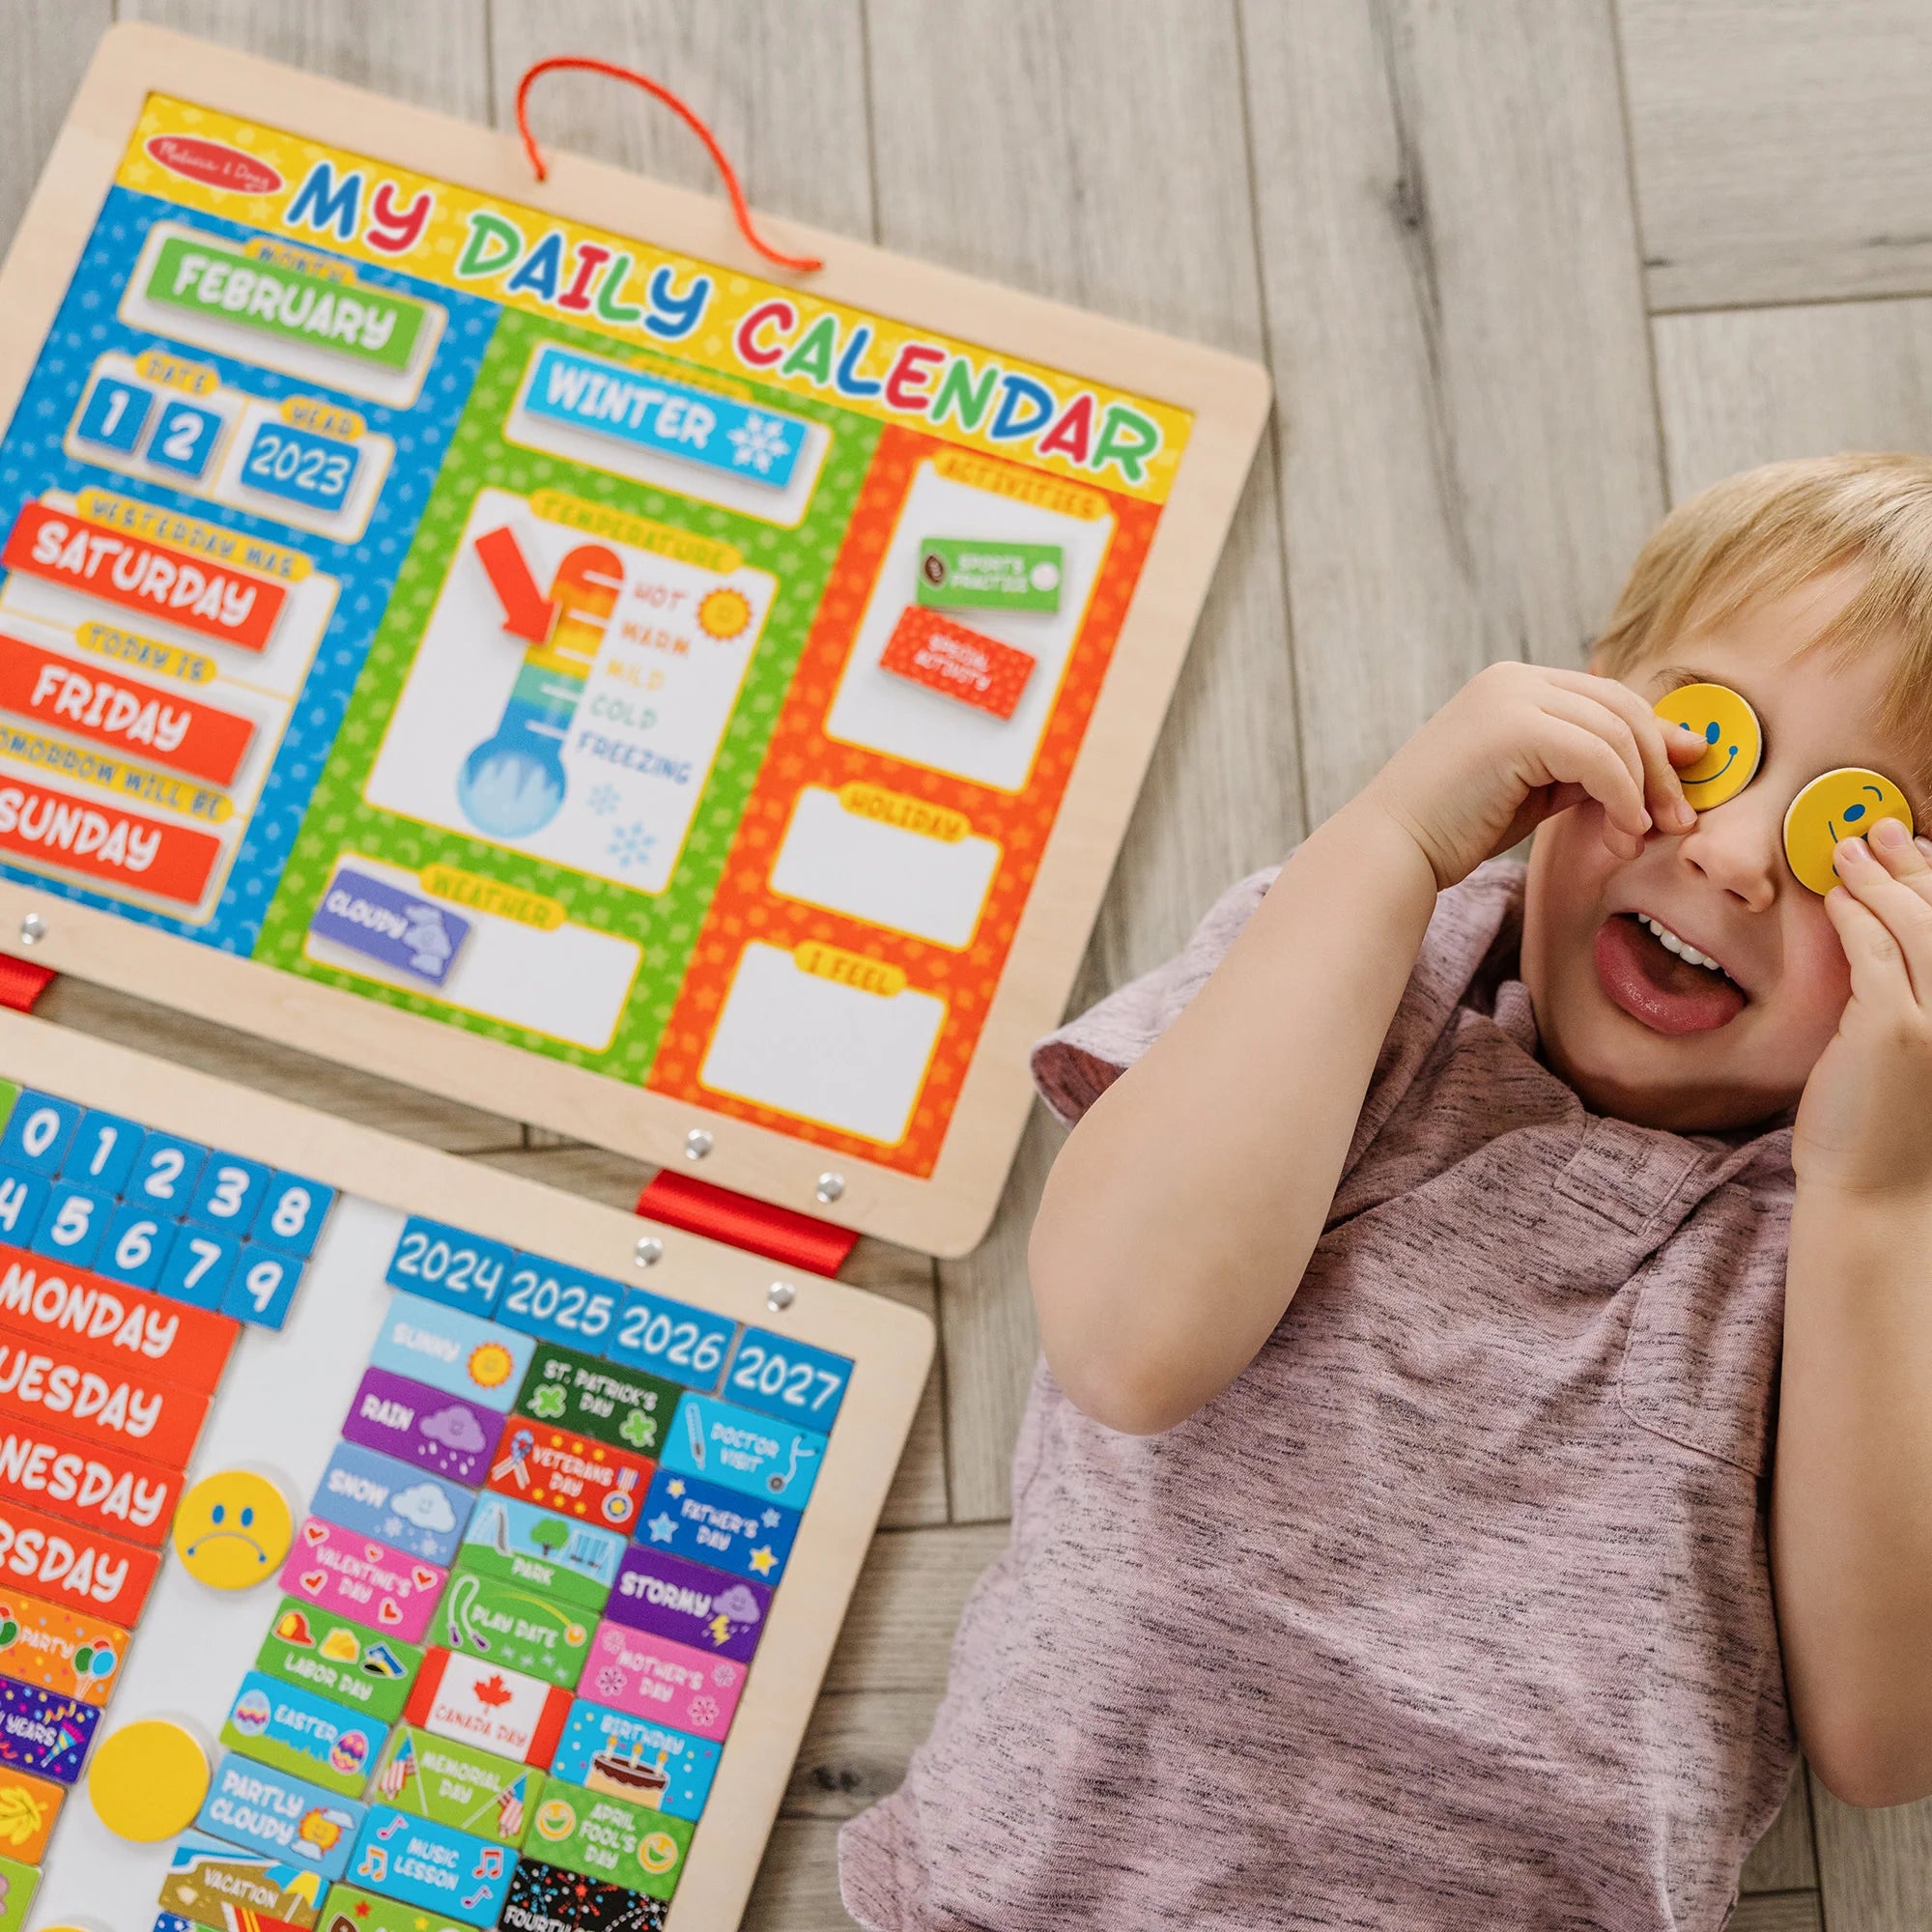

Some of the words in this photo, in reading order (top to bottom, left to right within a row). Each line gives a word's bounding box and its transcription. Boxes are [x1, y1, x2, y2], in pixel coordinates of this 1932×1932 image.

[172, 252, 398, 351] FEBRUARY
[286, 162, 431, 253] MY
[456, 213, 709, 336] DAILY
[736, 302, 1159, 482] CALENDAR
[145, 358, 207, 390] DATE
[546, 361, 717, 450] WINTER
[249, 435, 352, 496] 2023
[91, 498, 236, 559] YESTERDAY
[244, 545, 296, 575] WAS
[30, 520, 258, 627] SATURDAY
[634, 582, 688, 611] HOT
[88, 624, 169, 669] TODAY
[177, 656, 206, 682] IS
[619, 621, 691, 658] WARM
[606, 658, 667, 690] MILD
[30, 663, 192, 753] FRIDAY
[589, 695, 659, 731] COLD
[579, 731, 694, 786] FREEZING
[124, 770, 182, 807] WILL
[190, 787, 224, 820] BE
[850, 790, 962, 838] HOLIDAY
[0, 787, 162, 872] SUNDAY
[325, 890, 409, 940] CLOUDY
[431, 867, 552, 926] WEATHER
[832, 957, 891, 996] FEEL
[89, 1126, 119, 1176] 1
[144, 1148, 185, 1200] 2
[207, 1166, 250, 1218] 3
[270, 1186, 312, 1237] 8
[50, 1195, 95, 1246] 5
[115, 1220, 158, 1270] 6
[183, 1238, 222, 1290] 7
[395, 1231, 504, 1302] 2024
[245, 1260, 284, 1313] 9
[504, 1270, 615, 1336] 2025
[0, 1262, 181, 1359] MONDAY
[391, 1321, 462, 1364] SUNNY
[617, 1304, 725, 1373] 2026
[732, 1346, 841, 1411] 2027
[358, 1392, 416, 1433] RAIN
[580, 1391, 615, 1419] DAY
[710, 1420, 781, 1461] DOCTOR
[719, 1447, 765, 1475] VISIT
[0, 1434, 168, 1528] NESDAY
[327, 1467, 390, 1509] SNOW
[531, 1444, 616, 1489] VETERANS
[548, 1470, 584, 1498] DAY
[681, 1496, 759, 1540] FATHER'S
[695, 1523, 732, 1552] DAY
[315, 1546, 412, 1599] VALENTINE'S
[337, 1576, 374, 1605] DAY
[511, 1556, 555, 1587] PARK
[619, 1569, 713, 1620] STORMY
[19, 1627, 74, 1660] PARTY
[470, 1604, 515, 1635] PLAY
[514, 1620, 559, 1650] DATE
[283, 1651, 338, 1690] LABOR
[338, 1675, 374, 1702] DAY
[617, 1648, 704, 1692] MOTHER'S
[638, 1676, 676, 1704] DAY
[273, 1703, 338, 1745] EASTER
[435, 1704, 494, 1738] CANADA
[496, 1722, 530, 1749] DAY
[599, 1714, 686, 1756] BIRTHDAY
[221, 1769, 305, 1818] PARTLY
[420, 1749, 503, 1792] MEMORIAL
[439, 1777, 474, 1804] DAY
[209, 1797, 296, 1847] CLOUDY
[579, 1818, 638, 1855] FOOL'S
[588, 1803, 637, 1833] APRIL
[393, 1855, 461, 1892] LESSON
[406, 1835, 462, 1869] MUSIC
[583, 1844, 620, 1871] DAY
[203, 1865, 280, 1910] VACATION
